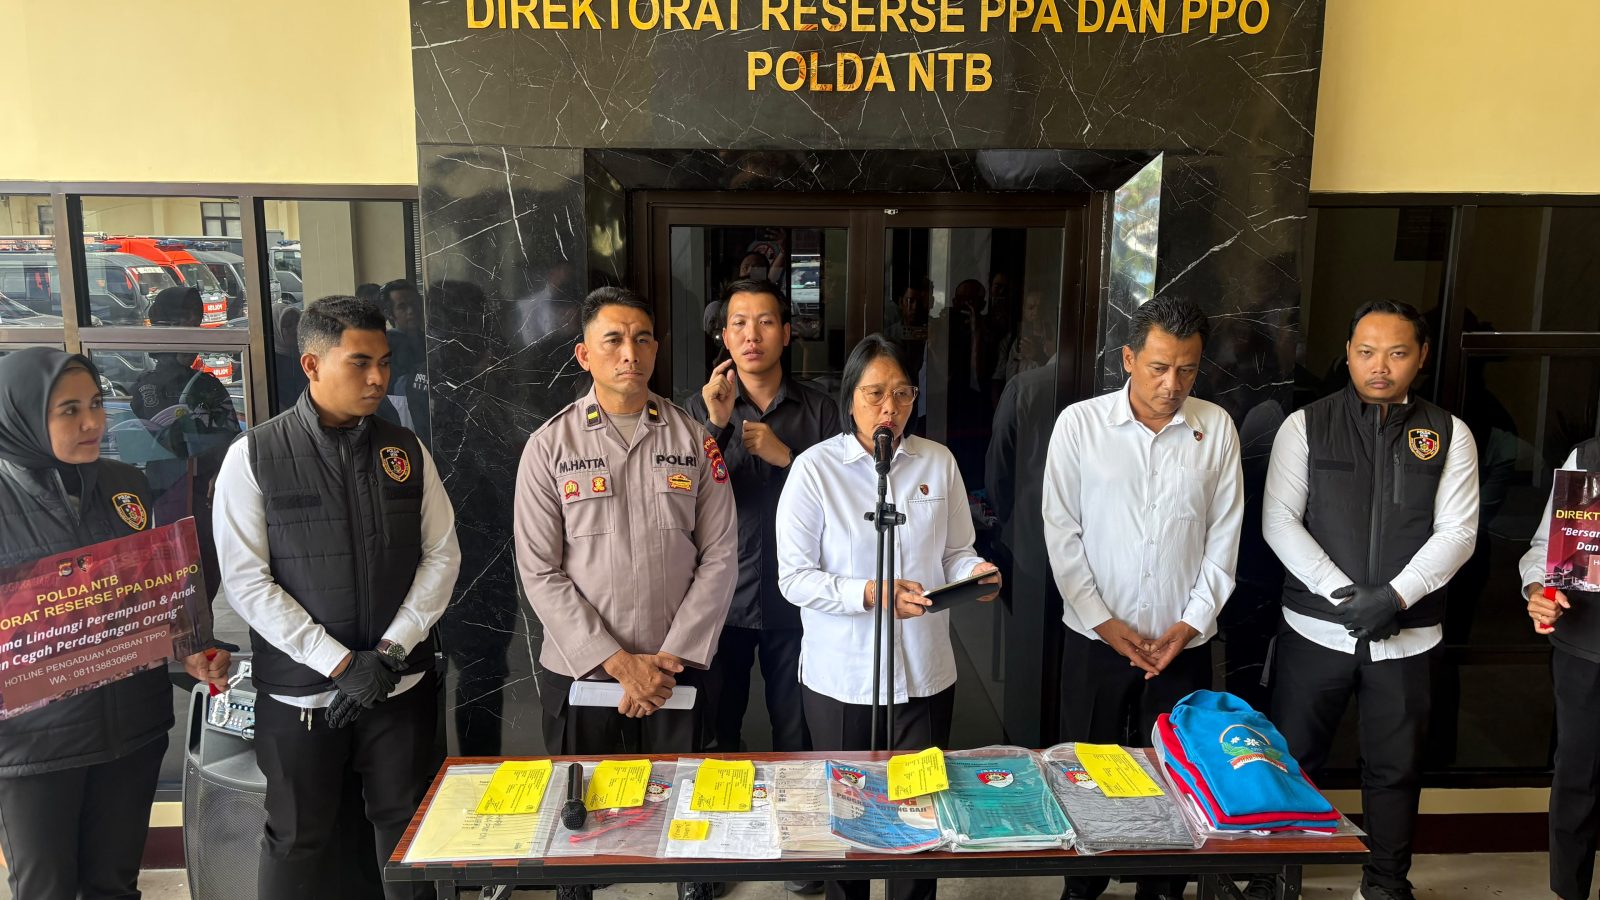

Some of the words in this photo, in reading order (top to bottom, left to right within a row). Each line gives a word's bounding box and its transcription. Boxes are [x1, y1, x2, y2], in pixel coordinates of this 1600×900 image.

[762, 0, 964, 33] RESERSE
[980, 0, 1062, 33] PPA
[1077, 0, 1165, 34] DAN
[1181, 0, 1270, 34] PPO
[747, 51, 896, 92] POLDA
[908, 52, 993, 92] NTB
[559, 458, 605, 473] M.HATTA
[656, 454, 697, 467] POLRI
[1556, 510, 1600, 520] DIREKT
[1576, 542, 1599, 552] Dan
[37, 584, 88, 605] POLDA
[91, 575, 119, 591] NTB
[45, 591, 113, 618] RESERSE
[116, 583, 142, 599] PPA
[145, 573, 172, 589] DAN
[176, 564, 198, 580] PPO
[27, 620, 83, 645] Lindungi
[87, 599, 156, 628] Perempuan
[160, 593, 167, 605] &
[171, 584, 196, 602] Anak
[5, 668, 44, 688] HOTLINE
[46, 651, 104, 673] PENGADUAN
[106, 639, 143, 655] KORBAN
[145, 630, 167, 643] TPPO
[13, 646, 52, 667] Cegah
[57, 623, 139, 653] Perdagangan
[49, 674, 67, 686] WA
